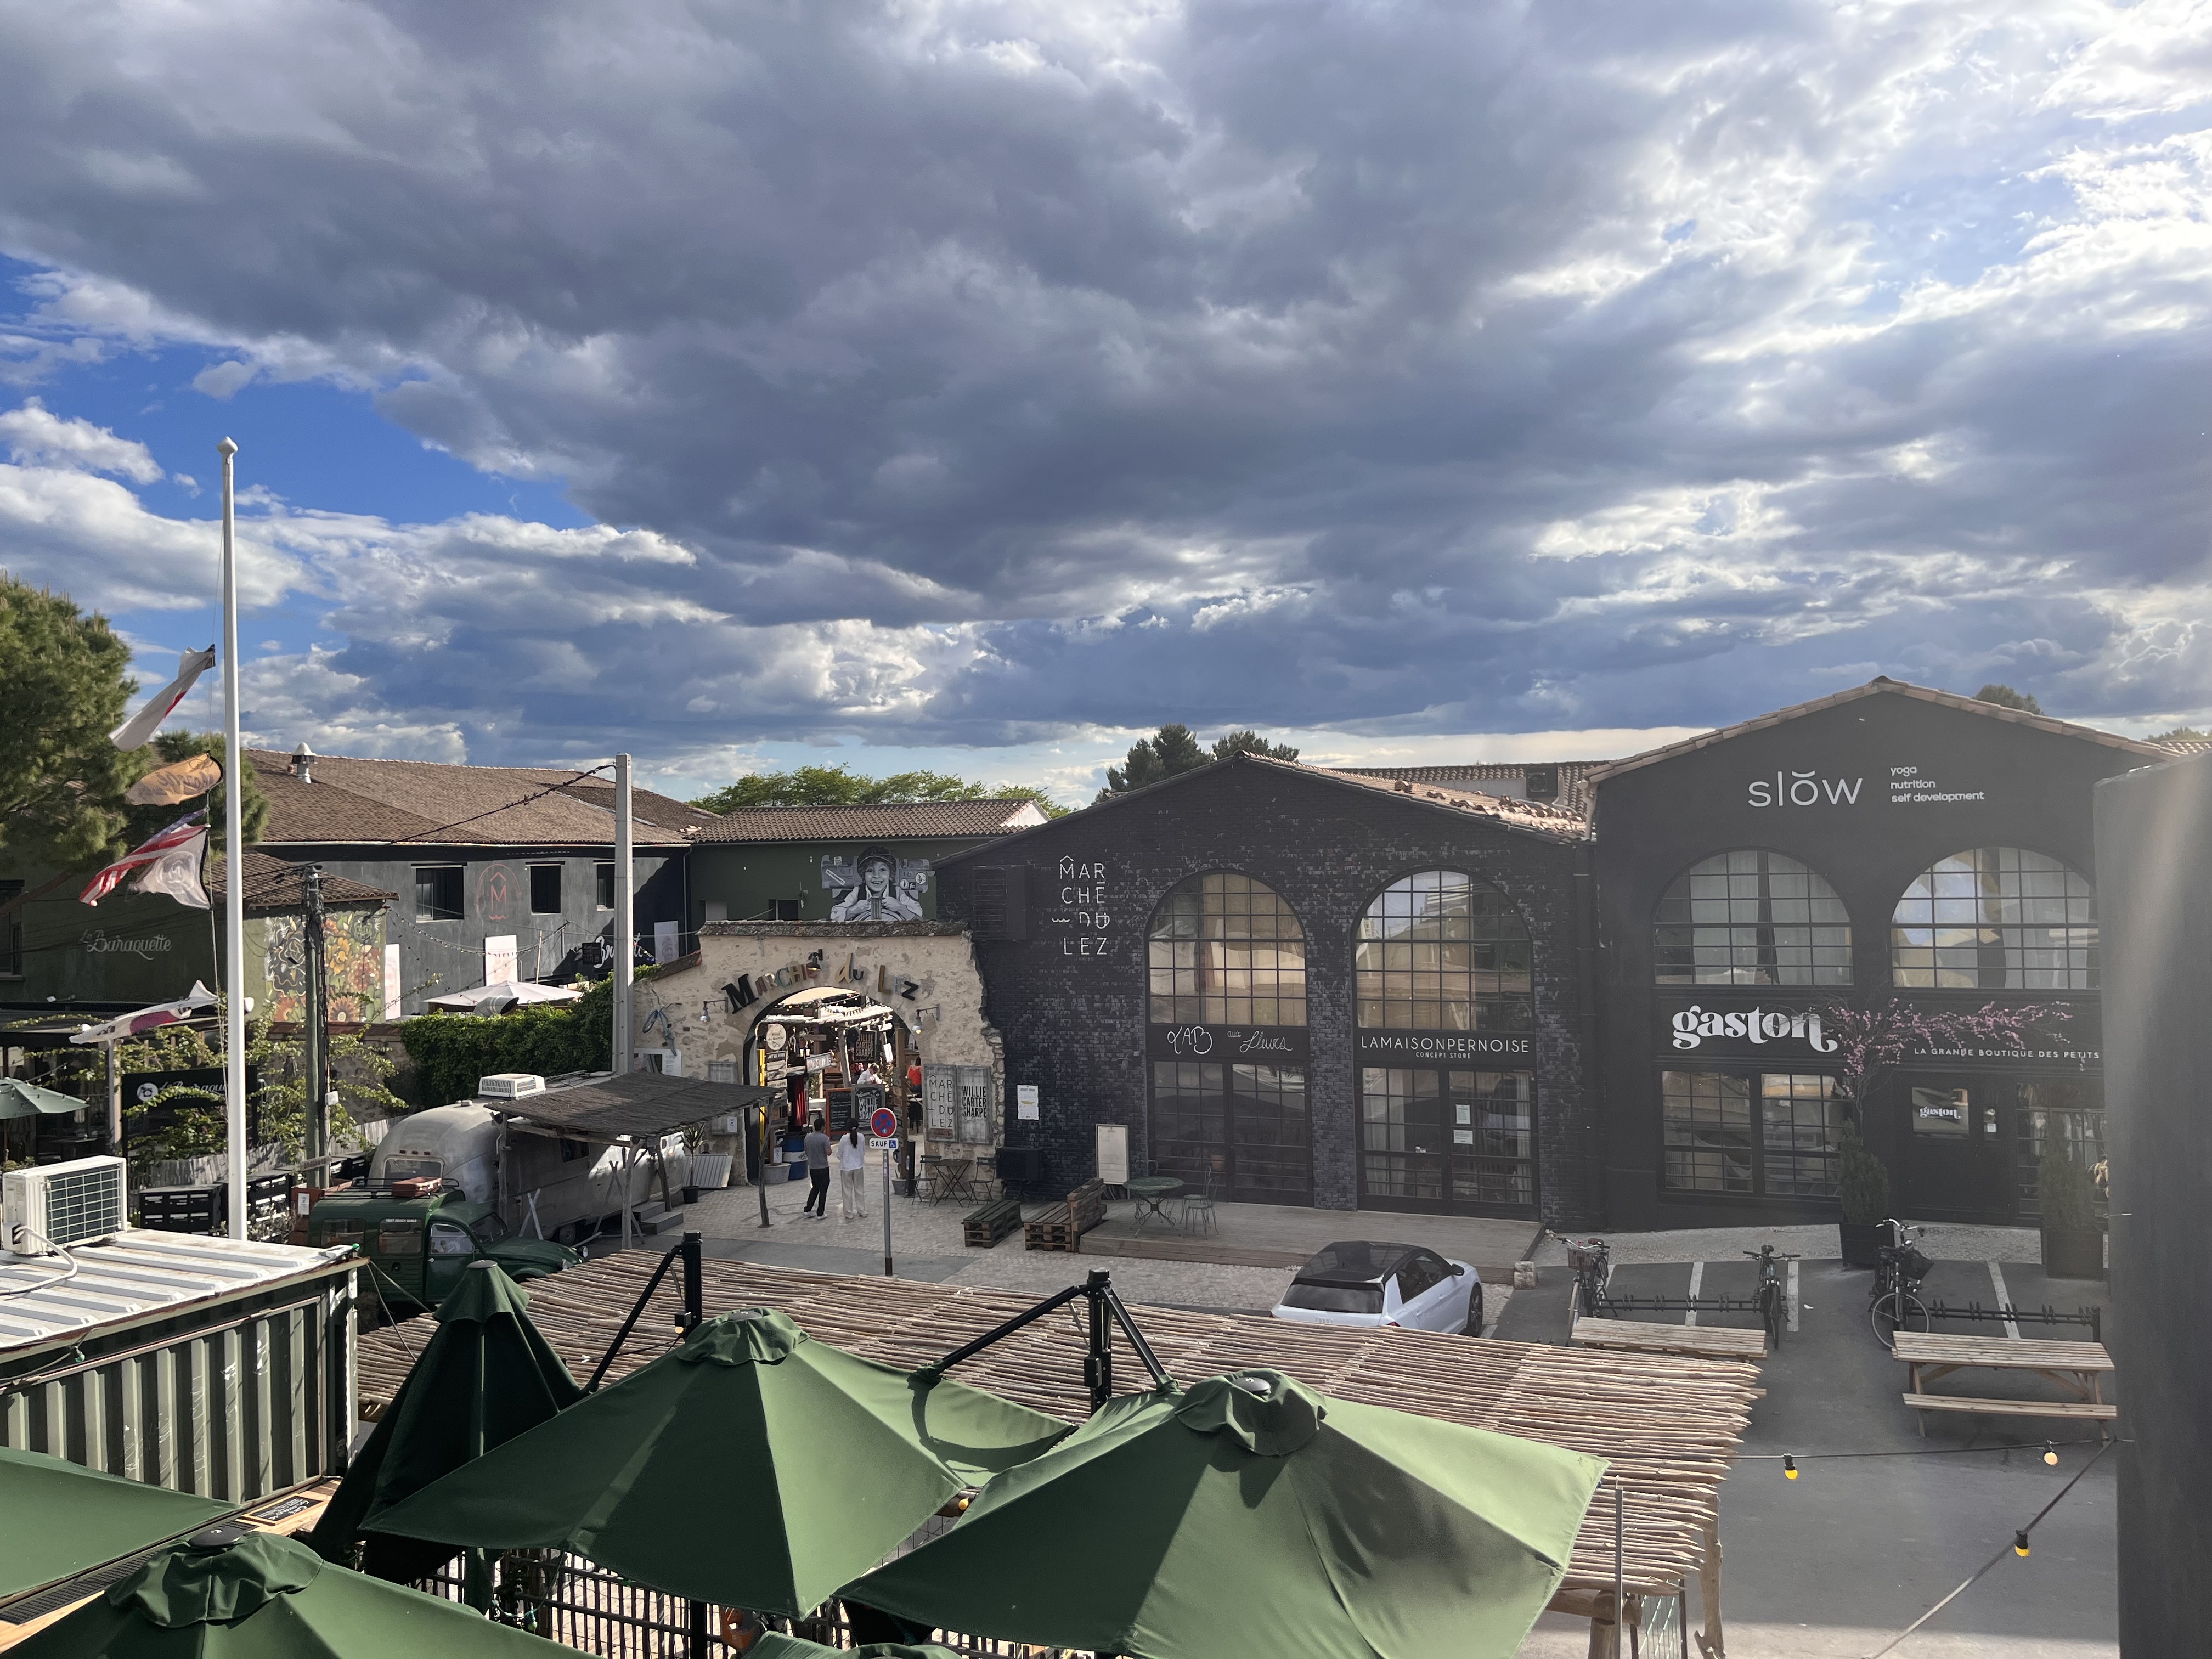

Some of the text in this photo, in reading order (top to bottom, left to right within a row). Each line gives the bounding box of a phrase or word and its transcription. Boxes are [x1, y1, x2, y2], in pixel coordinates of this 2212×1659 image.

[1890, 766, 1917, 777] yoga
[1891, 780, 1936, 789] nutrition
[1891, 791, 1985, 803] self development
[1063, 937, 1107, 955] LEZ
[835, 952, 864, 984] du
[877, 964, 919, 1001] LEZ
[1672, 1005, 1838, 1052] gaston
[1361, 1036, 1529, 1053] LAMAISONPERNOISE
[856, 1049, 873, 1057] SHARPE
[1978, 1049, 2033, 1058] BOUTIQUE
[962, 1085, 986, 1097] WILLIE
[859, 1098, 878, 1107] WILLIE
[962, 1097, 986, 1108] CARTER
[962, 1107, 987, 1118] SHARPE
[1920, 1107, 1961, 1119] gaston
[932, 1117, 953, 1128] LEZ
